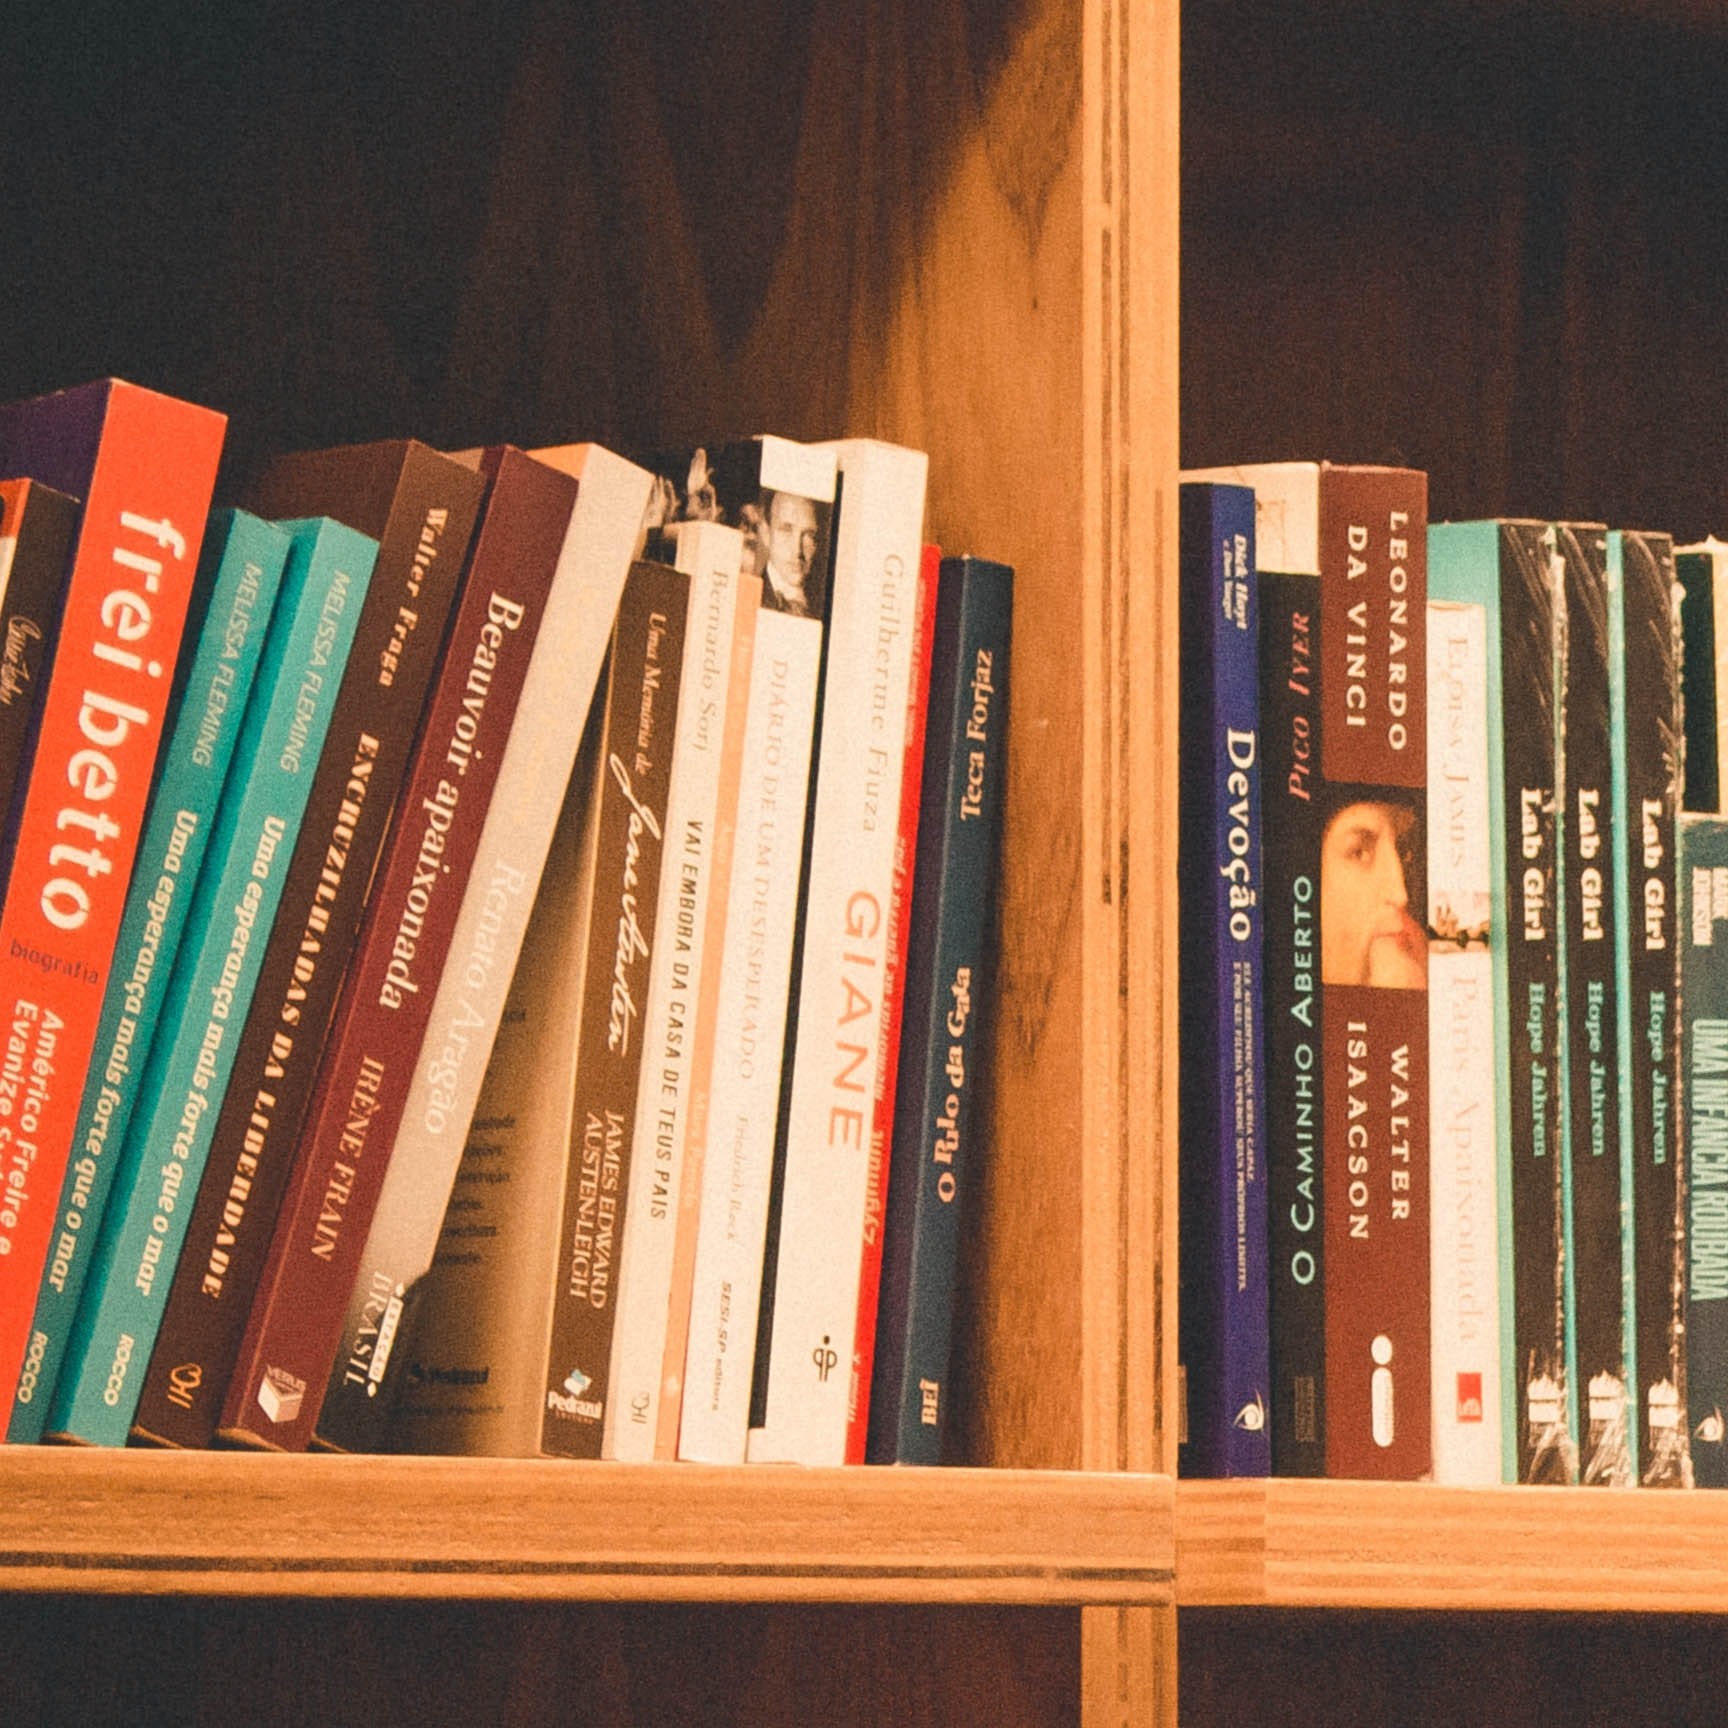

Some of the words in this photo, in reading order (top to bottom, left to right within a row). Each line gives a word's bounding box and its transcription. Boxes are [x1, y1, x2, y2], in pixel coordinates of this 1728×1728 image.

[89, 509, 192, 678] frei
[404, 505, 448, 599] Walter
[1347, 525, 1367, 579] DA
[374, 605, 418, 688] Fraga
[869, 553, 905, 729] Guilherme
[1346, 602, 1366, 725] VINCI
[1389, 511, 1407, 749] LEONARDO
[442, 592, 526, 779] Beauvoir
[964, 649, 997, 741] Forjaz
[34, 689, 150, 936] betto
[861, 747, 888, 832] Fiuza
[958, 750, 987, 821] Teca
[1520, 789, 1542, 857] Lab
[1577, 788, 1599, 858] Lab
[250, 815, 286, 879] Uma
[684, 820, 702, 854] VAI
[1219, 728, 1256, 941] Devoção
[1641, 799, 1662, 868] Lab
[280, 732, 380, 1025] ENCRUZILHADAS
[367, 776, 472, 1012] apaixonada
[675, 863, 698, 951] EMBORA
[1522, 868, 1543, 940] Girl
[1579, 867, 1601, 940] Girl
[1643, 877, 1664, 950] Girl
[206, 879, 263, 1019] esperança
[671, 962, 689, 990] DA
[1291, 875, 1312, 1026] ABERTO
[191, 1021, 228, 1090] mais
[263, 1031, 294, 1080] DA
[665, 1001, 685, 1058] CASA
[828, 889, 882, 1149] GIANE
[1526, 983, 1550, 1052] Hope
[1584, 981, 1604, 1052] Hope
[1647, 992, 1665, 1060] Hope
[19, 1010, 64, 1134] Américo
[338, 1056, 389, 1158] IRÈNE
[661, 1069, 679, 1094] DE
[1531, 1061, 1548, 1155] Jahren
[1590, 1060, 1606, 1155] Jahren
[171, 1090, 210, 1161] forte
[598, 1111, 624, 1191] JAMES
[655, 1109, 675, 1159] TEUS
[1289, 1043, 1314, 1231] CAMINHO
[1346, 1022, 1369, 1238] ISAACSON
[1390, 1045, 1409, 1218] WALTER
[1652, 1069, 1667, 1163] Jahren
[0, 1140, 36, 1228] Freire
[150, 1214, 170, 1234] o
[151, 1159, 185, 1212] que
[200, 1089, 276, 1297] LIBERDADE
[310, 1161, 355, 1260] FRAIN
[650, 1169, 670, 1218] PAIS
[132, 1234, 164, 1296] mar
[588, 1196, 617, 1308] EDWARD
[1291, 1250, 1315, 1284] O
[1690, 1191, 1728, 1300] ROUBADA
[102, 1333, 135, 1407] ROCCO
